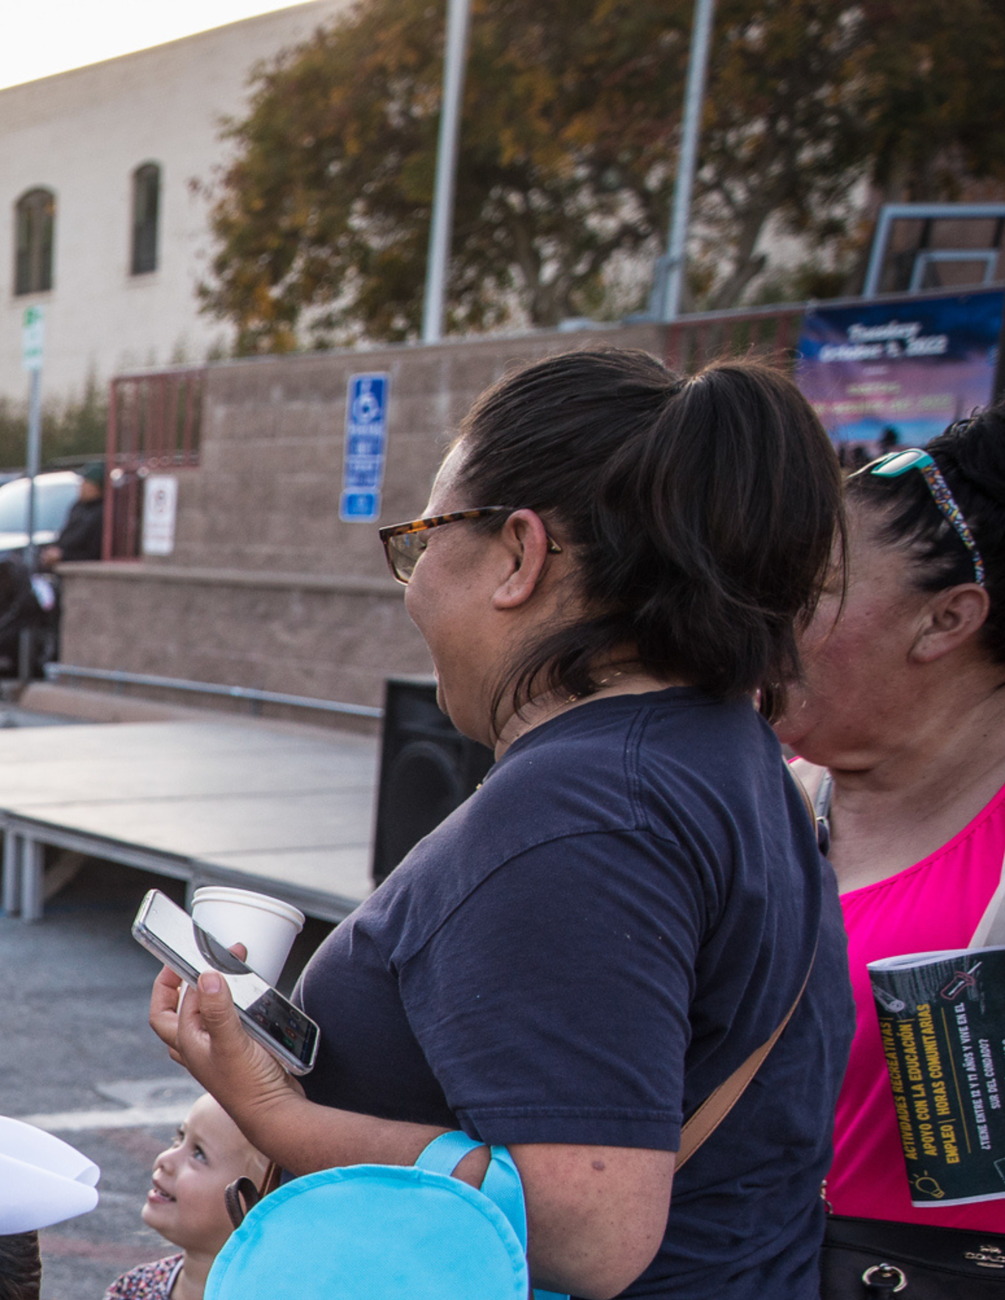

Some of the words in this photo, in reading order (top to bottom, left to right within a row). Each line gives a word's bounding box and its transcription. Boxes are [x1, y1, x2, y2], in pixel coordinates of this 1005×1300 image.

[954, 1002, 965, 1012] EL
[956, 1013, 967, 1024] EN
[917, 1003, 943, 1078] COMUNITARIAS
[957, 1026, 971, 1043] VIVE
[881, 1022, 904, 1092] RECREATIVAS
[896, 1024, 923, 1080] EDUCACIÓN
[962, 1052, 976, 1071] AÑOS
[978, 1038, 994, 1076] CONDADO?
[911, 1083, 927, 1097] LA
[985, 1078, 997, 1092] DEL
[932, 1081, 950, 1115] HORAS
[987, 1094, 1001, 1109] SUR
[914, 1100, 930, 1120] CON
[971, 1099, 987, 1123] ENTRE
[895, 1096, 918, 1160] ACTIVIDADES
[919, 1124, 938, 1156] APOYO
[940, 1125, 961, 1164] EMPLEO
[964, 1251, 1005, 1263] COAC
